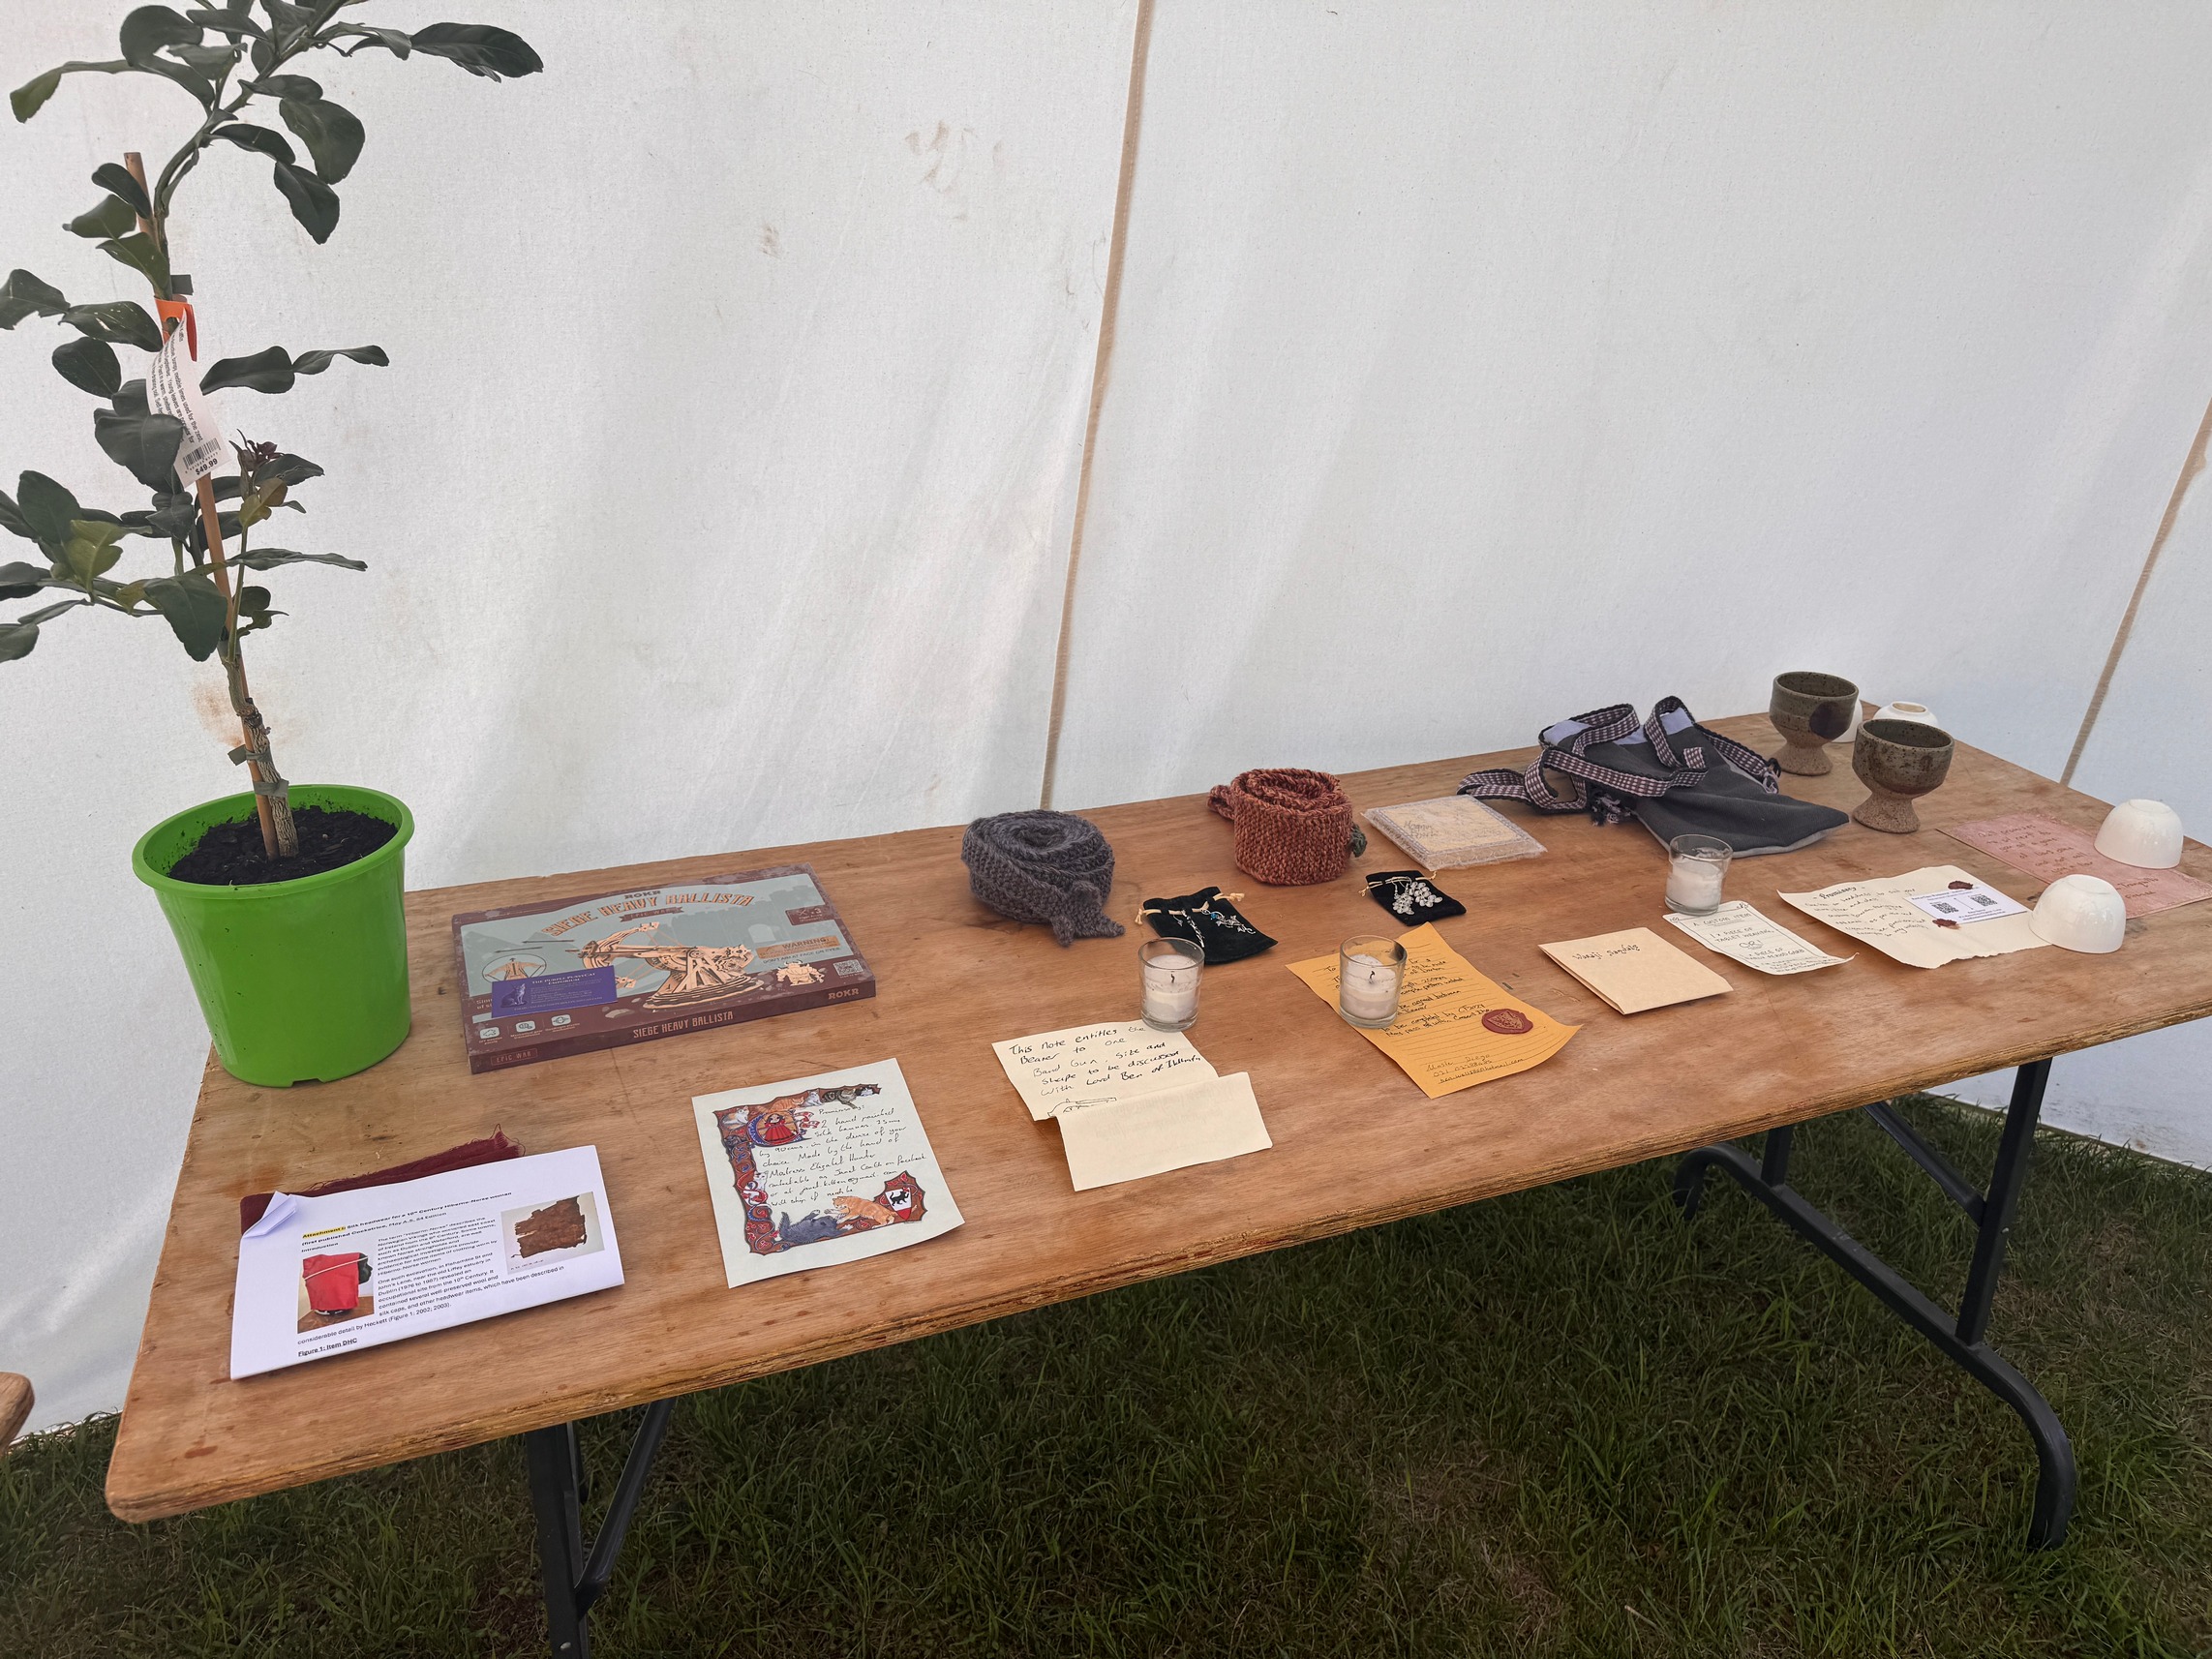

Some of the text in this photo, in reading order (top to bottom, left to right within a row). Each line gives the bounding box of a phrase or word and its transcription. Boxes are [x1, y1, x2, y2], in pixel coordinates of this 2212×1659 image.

[171, 392, 179, 409] leaves
[183, 402, 192, 414] used
[195, 458, 218, 476] $49.99
[624, 890, 661, 899] ROKR
[541, 892, 755, 937] SIEGE HEAVY BALLISTA
[781, 937, 830, 949] WARNING!
[828, 987, 860, 1001] ROKR
[1411, 991, 1461, 1007] agreed between
[633, 1011, 734, 1039] SIEGE HEAVY BALLISTA
[1009, 1044, 1033, 1055] This
[1075, 1029, 1118, 1043] entitles
[1020, 1052, 1061, 1064] Bearer
[1105, 1038, 1127, 1046] one
[496, 1050, 532, 1063] EPIC WAR
[1033, 1064, 1061, 1078] Band
[1086, 1073, 1111, 1086] Lord
[1121, 1071, 1143, 1081] Ben
[1151, 1063, 1164, 1073] of
[759, 1149, 771, 1158] by
[875, 1126, 885, 1136] of
[889, 1126, 907, 1136] your
[798, 1152, 821, 1161] Made
[827, 1147, 838, 1156] by
[841, 1143, 852, 1151] the
[859, 1137, 882, 1147] hand
[888, 1133, 899, 1143] of
[303, 1227, 341, 1238] Attachment
[419, 1206, 444, 1215] Century
[439, 1270, 464, 1281] revealed
[378, 1290, 416, 1303] occupational
[379, 1298, 409, 1310] contained
[409, 1293, 430, 1302] several
[430, 1282, 472, 1297] well-preserved
[390, 1307, 407, 1315] caps,
[419, 1298, 435, 1307] other
[436, 1291, 464, 1302] headwear
[483, 1281, 501, 1290] which
[501, 1277, 515, 1285] have
[515, 1273, 530, 1282] been
[530, 1267, 559, 1279] described
[297, 1331, 337, 1345] considerable
[338, 1326, 355, 1335] detail
[389, 1312, 408, 1324] (Figure
[416, 1307, 432, 1316] 2002;
[298, 1348, 318, 1357] Figure
[327, 1342, 341, 1351] Item
[342, 1337, 358, 1347] DHC
